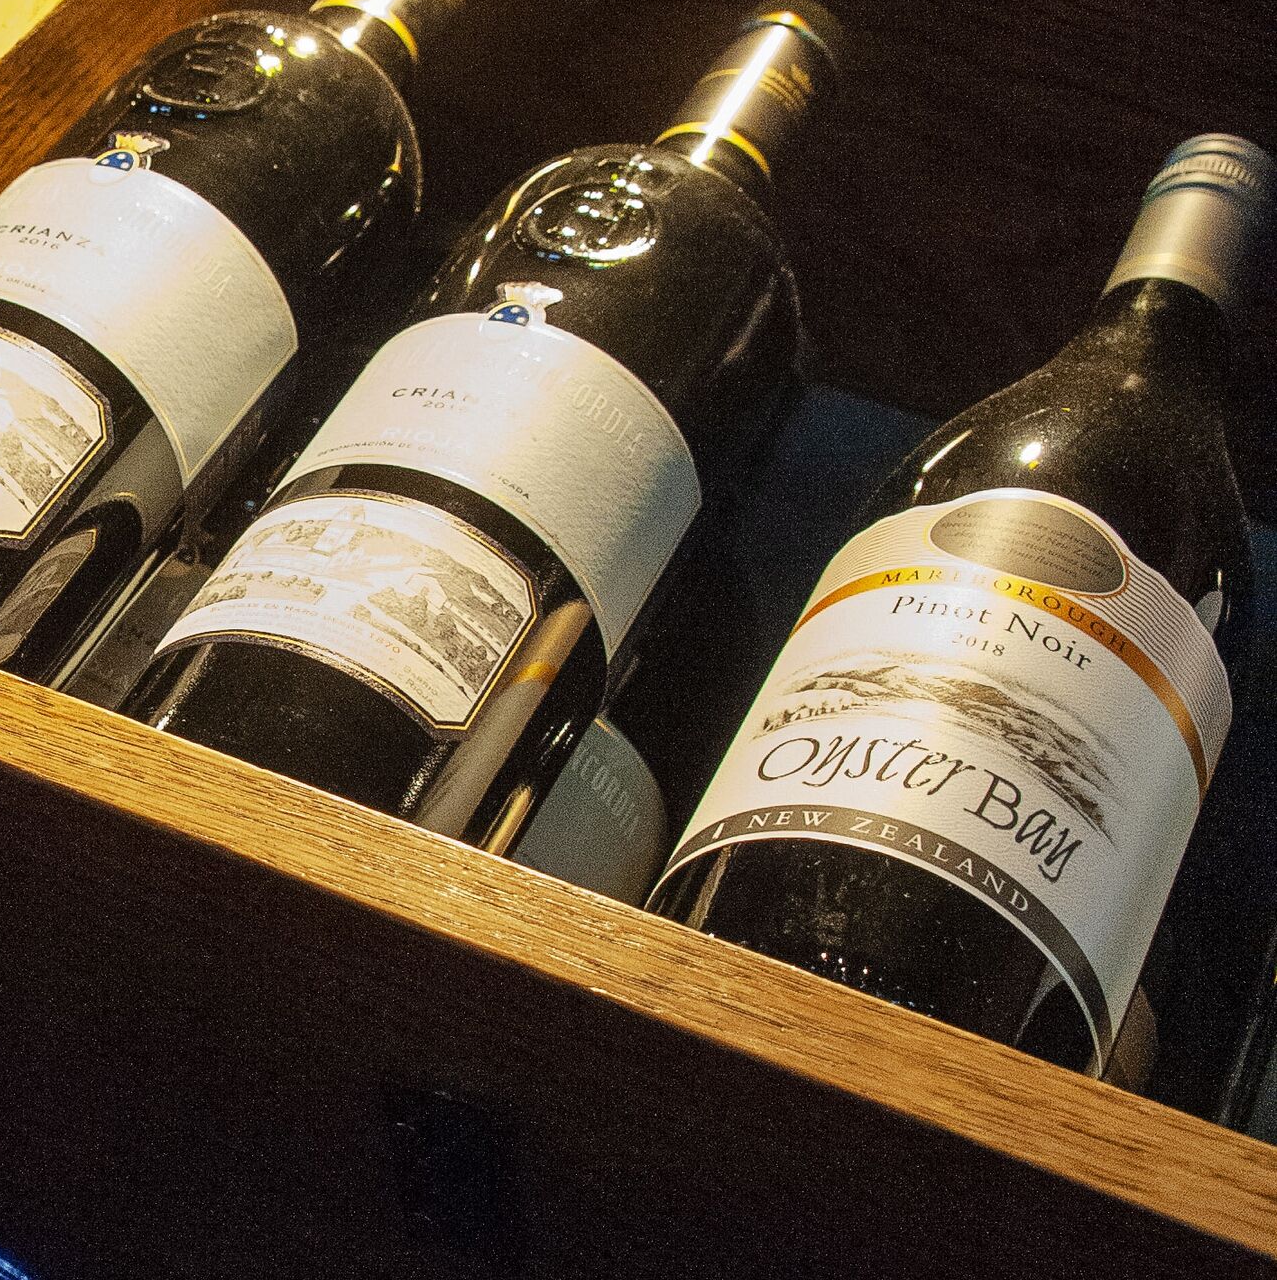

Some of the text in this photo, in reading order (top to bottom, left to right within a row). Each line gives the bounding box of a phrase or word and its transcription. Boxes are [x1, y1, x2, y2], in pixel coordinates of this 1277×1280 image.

[890, 594, 1093, 672] Pinot Noir
[951, 632, 1007, 658] 2018
[756, 732, 1081, 884] Oyster Bay
[746, 809, 1032, 915] NEW ZEALAND
